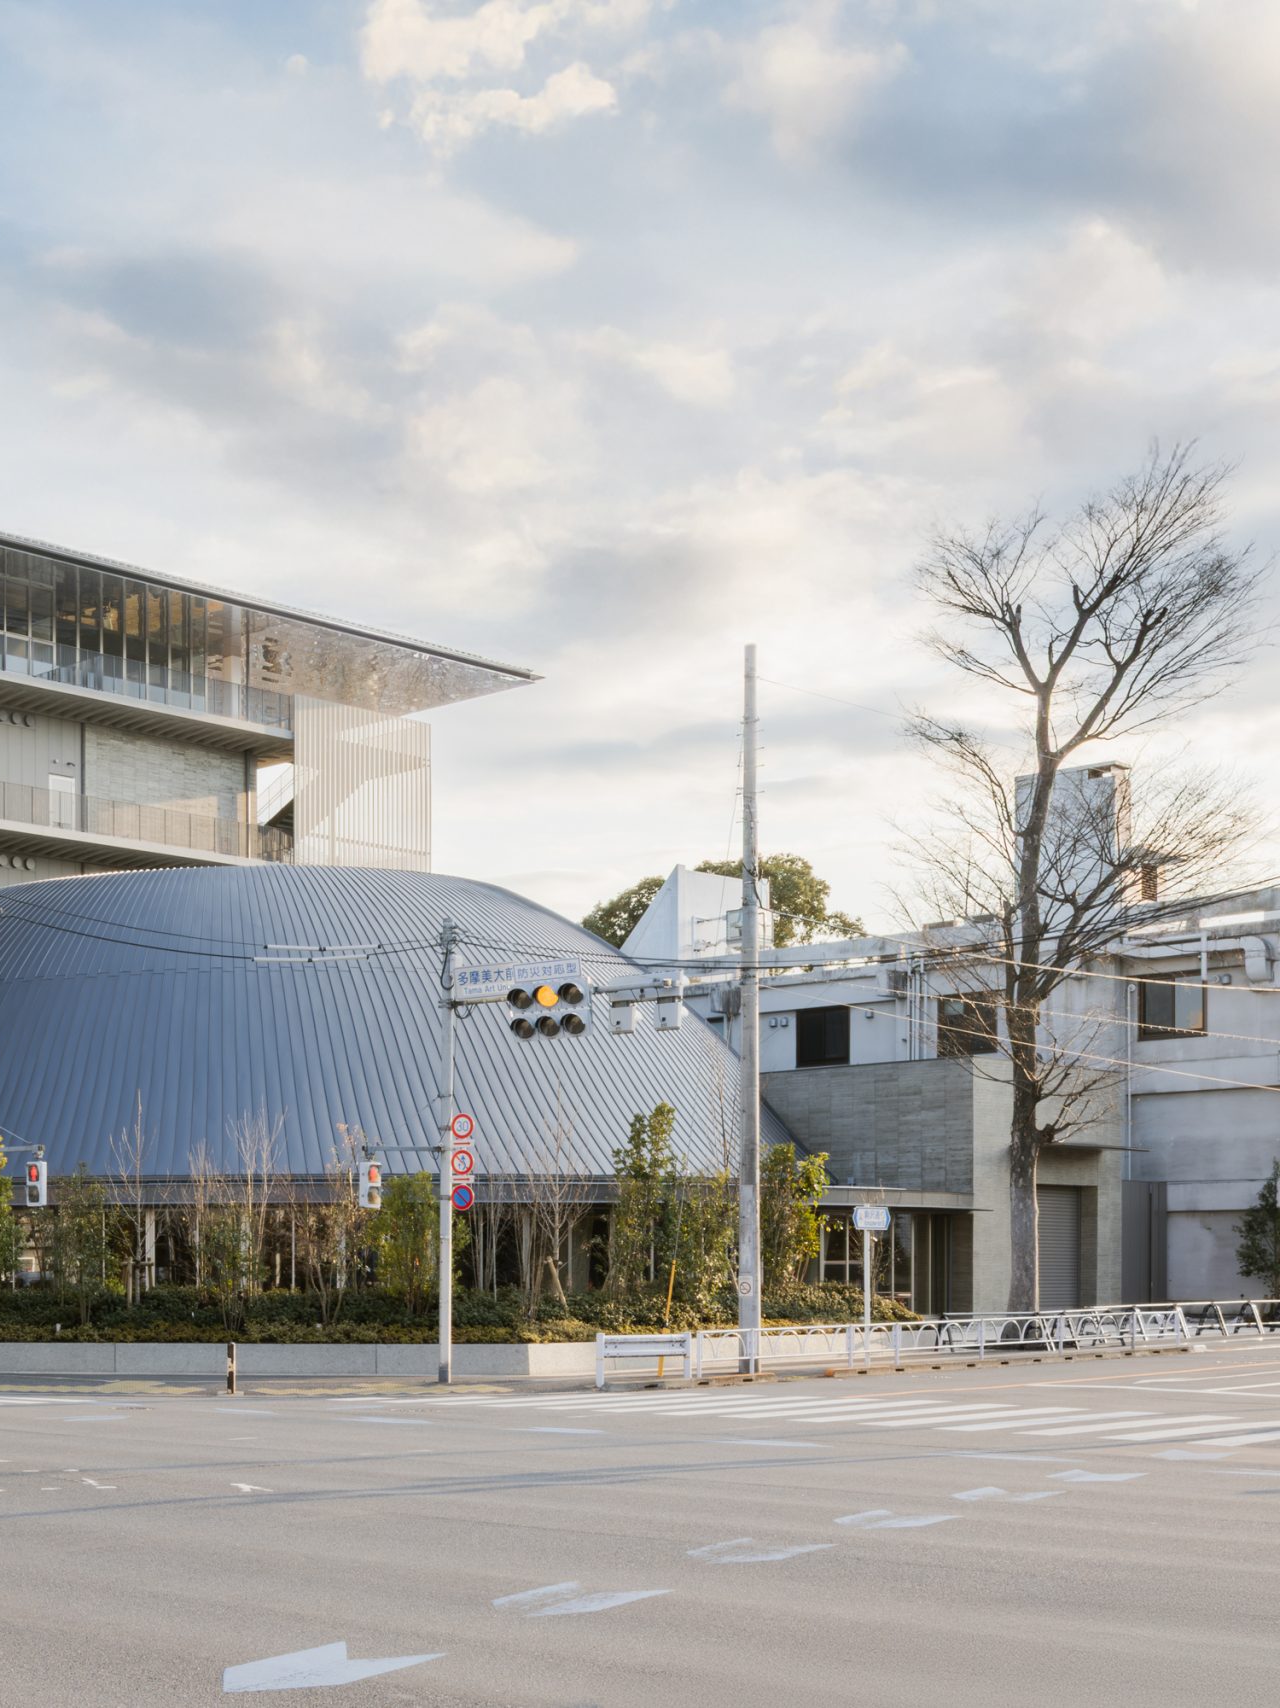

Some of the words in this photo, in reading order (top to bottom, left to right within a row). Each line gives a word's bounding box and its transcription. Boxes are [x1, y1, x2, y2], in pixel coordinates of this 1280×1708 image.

[517, 962, 577, 979] 防災対応型
[464, 986, 482, 995] Tama
[484, 984, 495, 993] Art
[456, 1121, 469, 1132] 30
